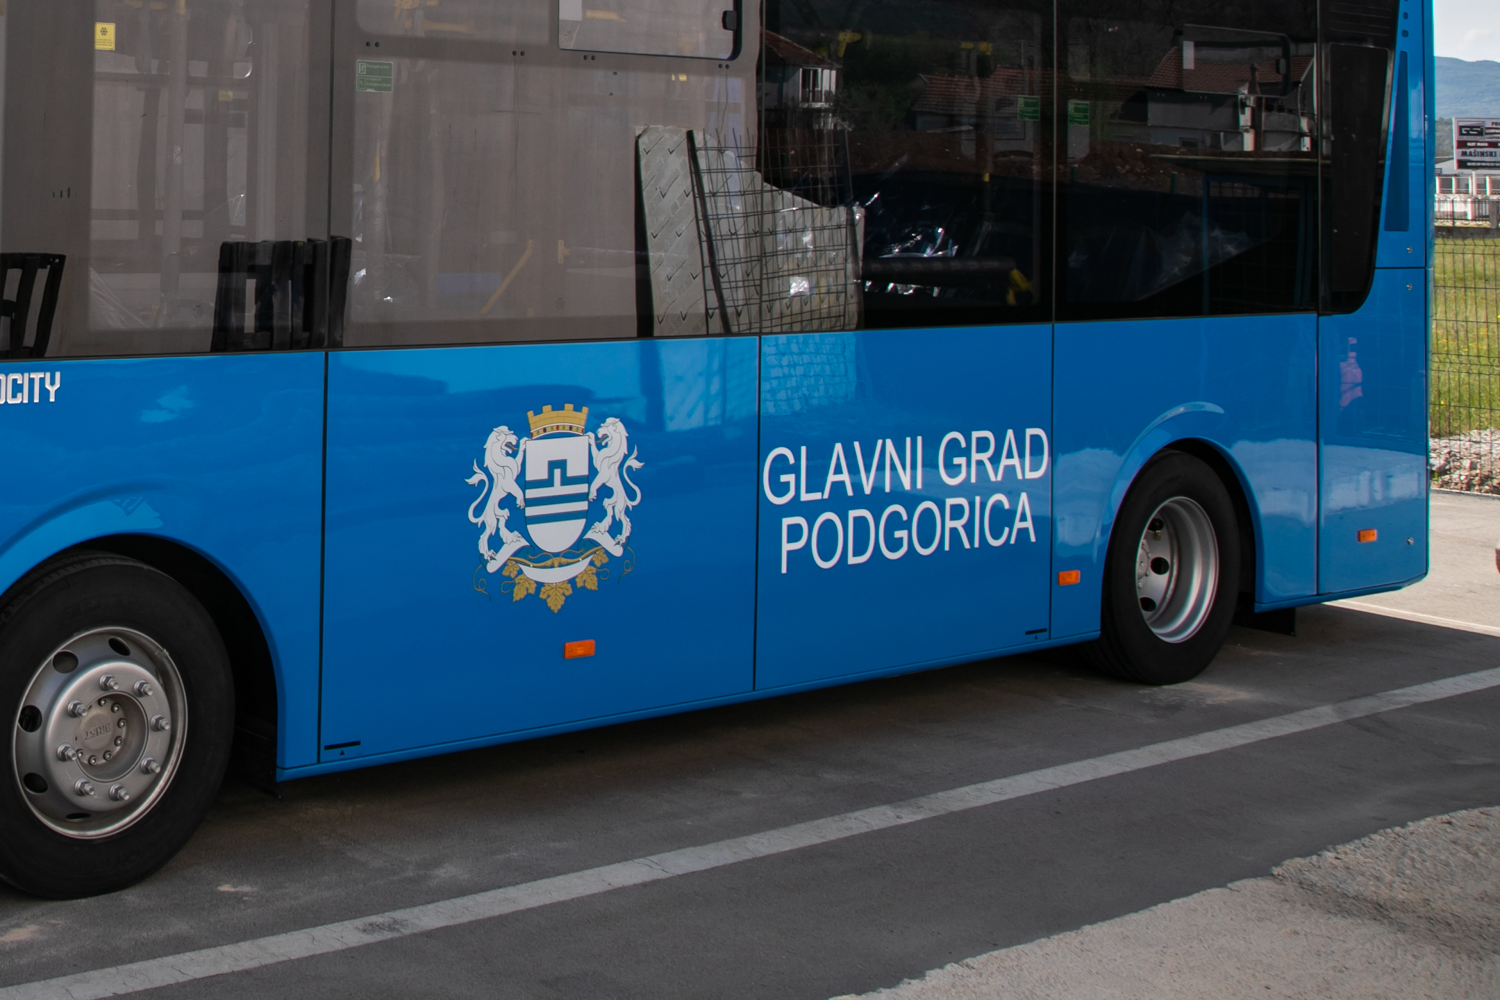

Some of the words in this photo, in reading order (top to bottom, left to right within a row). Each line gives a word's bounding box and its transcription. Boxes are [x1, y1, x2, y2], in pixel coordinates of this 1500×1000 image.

[763, 435, 923, 506] GLAVNI
[938, 428, 1049, 486] GRAD
[781, 492, 1037, 574] PODGORICA
